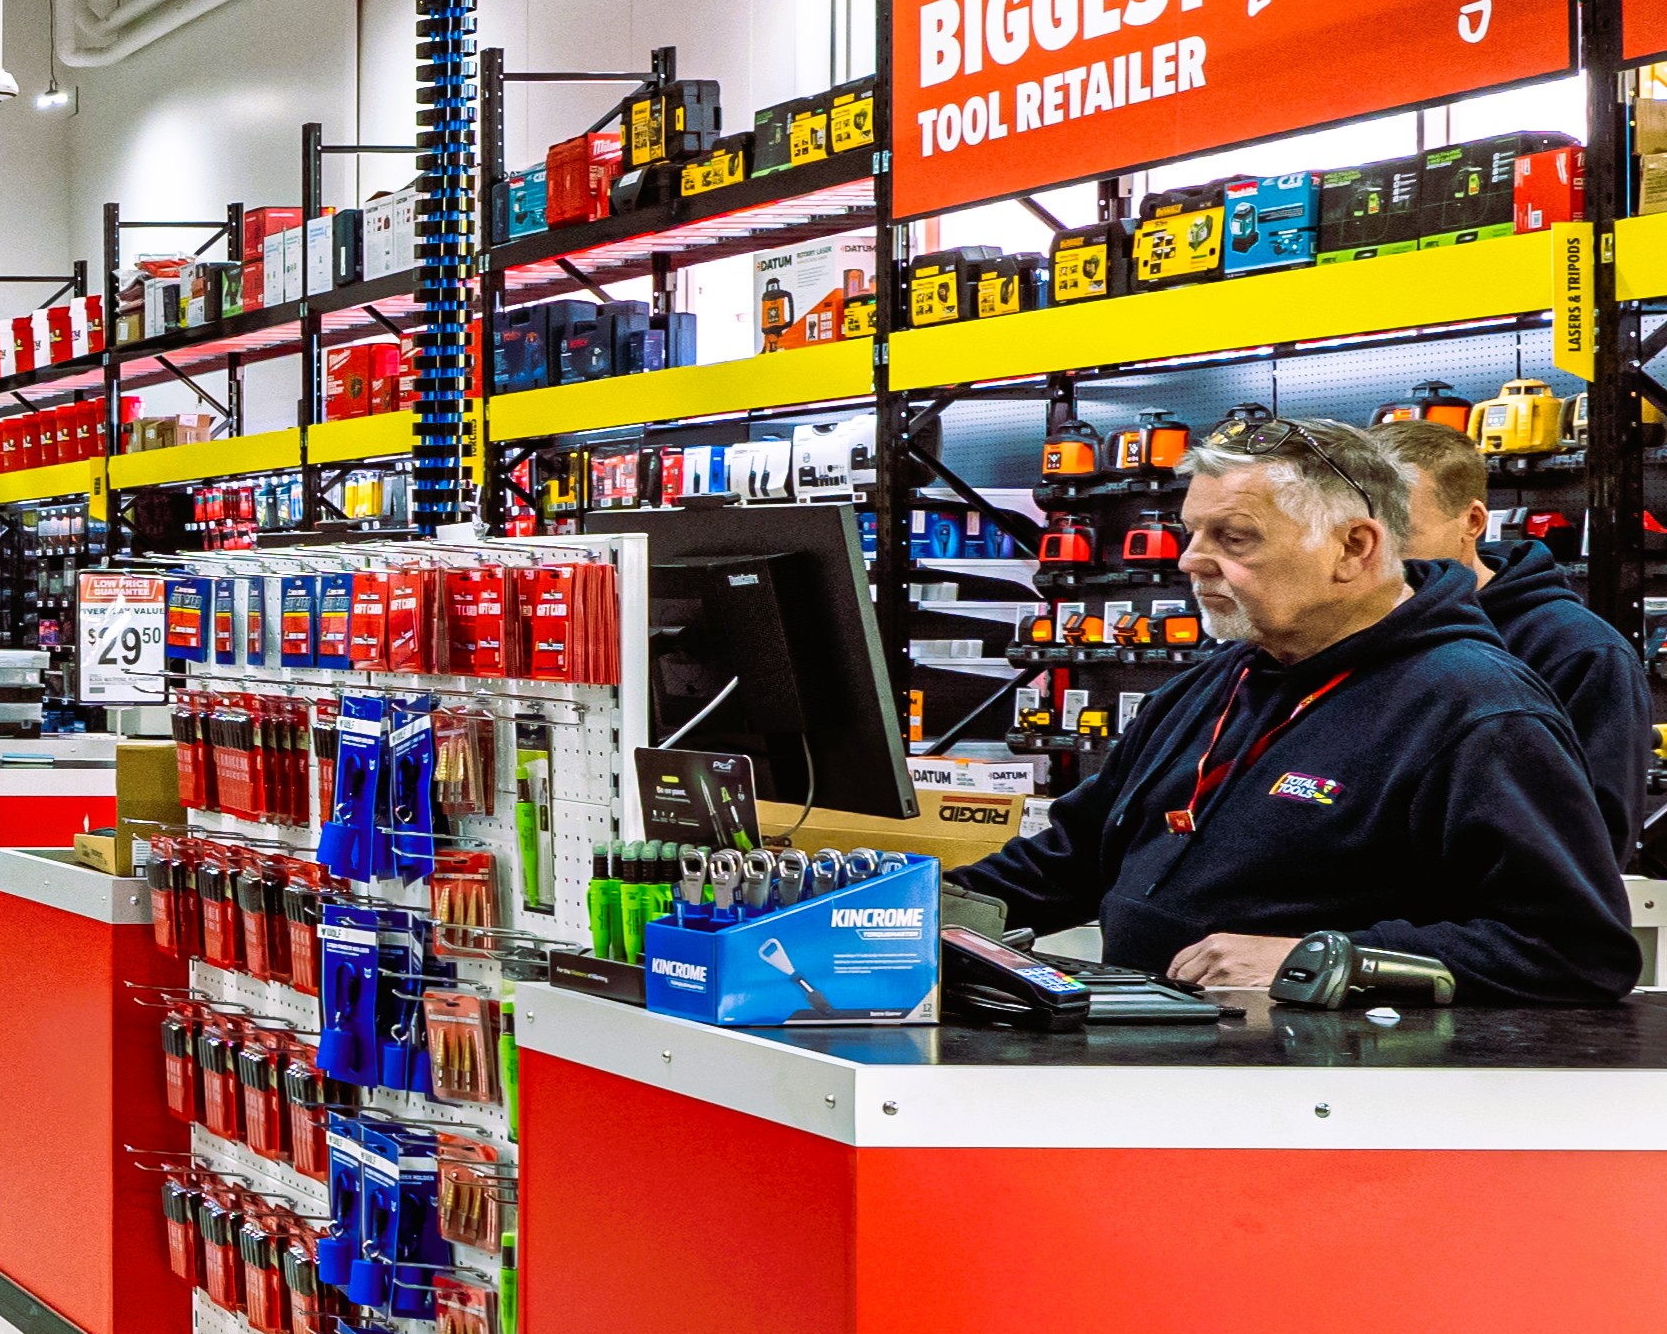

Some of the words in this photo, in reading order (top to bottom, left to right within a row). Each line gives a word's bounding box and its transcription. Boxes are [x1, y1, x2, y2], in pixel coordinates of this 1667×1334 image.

[917, 93, 1007, 158] TOOL
[1015, 35, 1207, 136] RETAILER
[760, 254, 792, 272] DATUM
[1567, 237, 1580, 292] TRIPODS
[1568, 294, 1581, 304] &
[1568, 306, 1581, 352] LASERS
[93, 577, 116, 589] LOW
[120, 578, 150, 589] PRICE
[93, 587, 150, 597] GUARANTEE
[913, 770, 951, 785] DATUM
[993, 771, 1028, 780] DATUM
[1287, 774, 1317, 787] TOTAL
[1279, 784, 1314, 799] TOOLS
[941, 806, 1009, 825] RIDGID
[831, 908, 924, 928] KINCROME
[652, 957, 707, 983] KINCROME
[922, 1003, 932, 1013] 12
